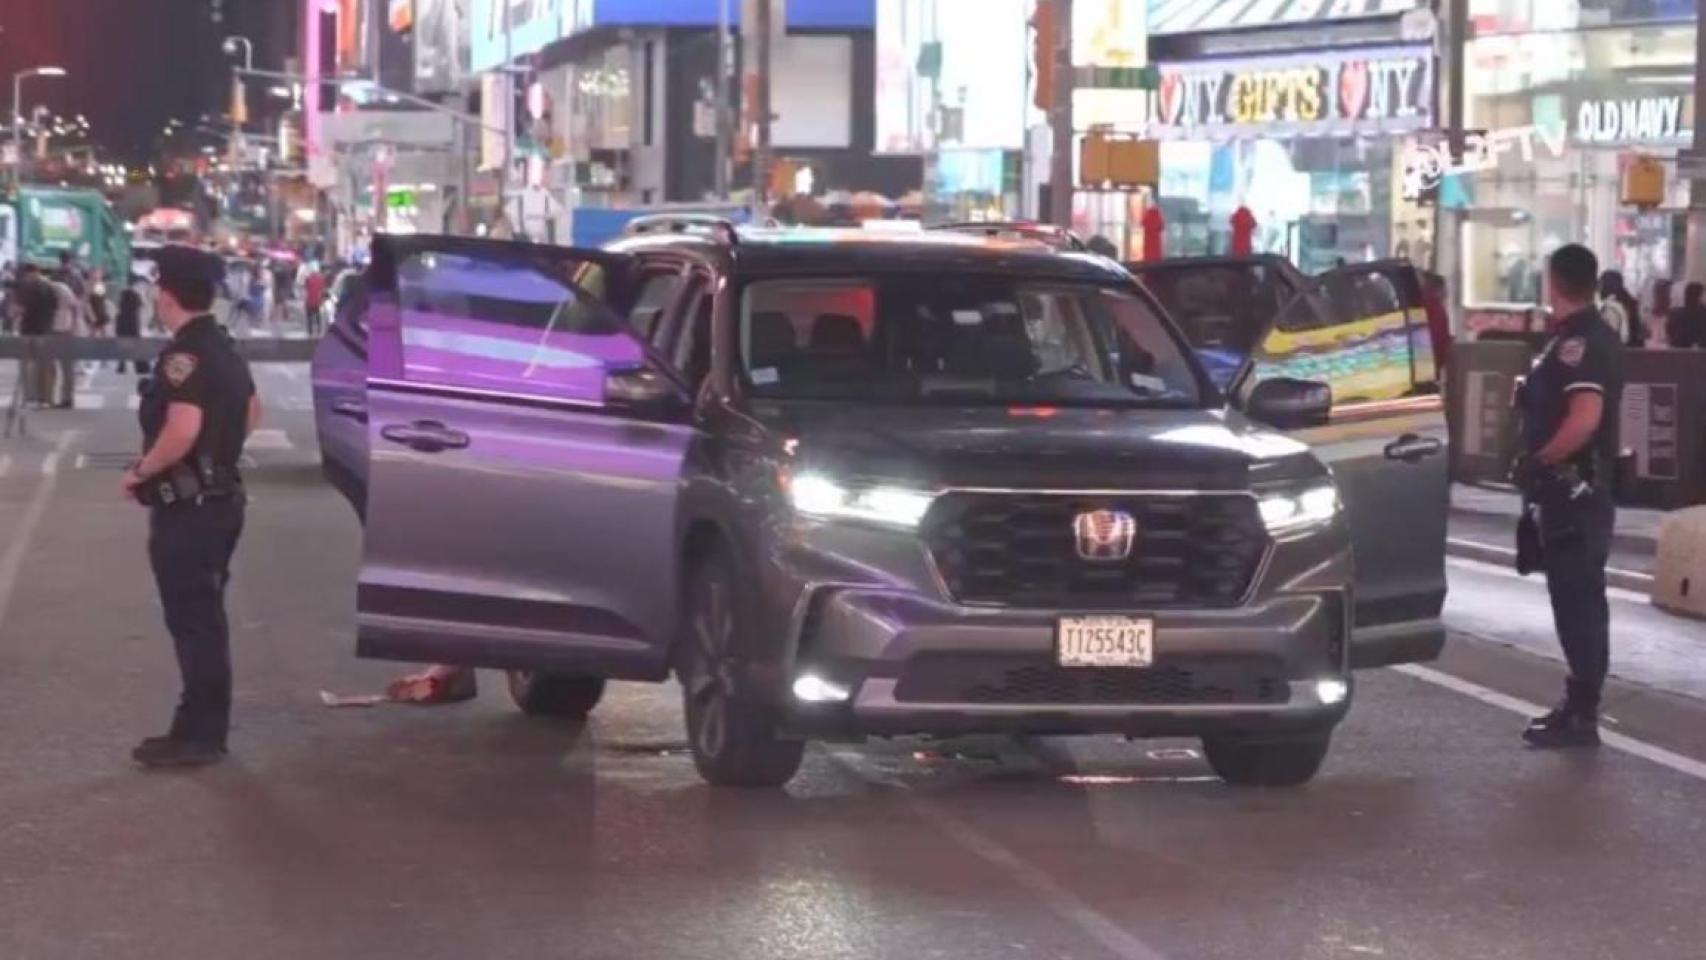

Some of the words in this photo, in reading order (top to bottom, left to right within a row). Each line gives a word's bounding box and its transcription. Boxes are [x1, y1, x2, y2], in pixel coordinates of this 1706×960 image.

[1182, 73, 1223, 122] NY
[1231, 69, 1321, 121] GIFTS
[1578, 98, 1620, 141] OLD
[1620, 96, 1680, 138] NAVY
[1065, 628, 1146, 655] T125543C
